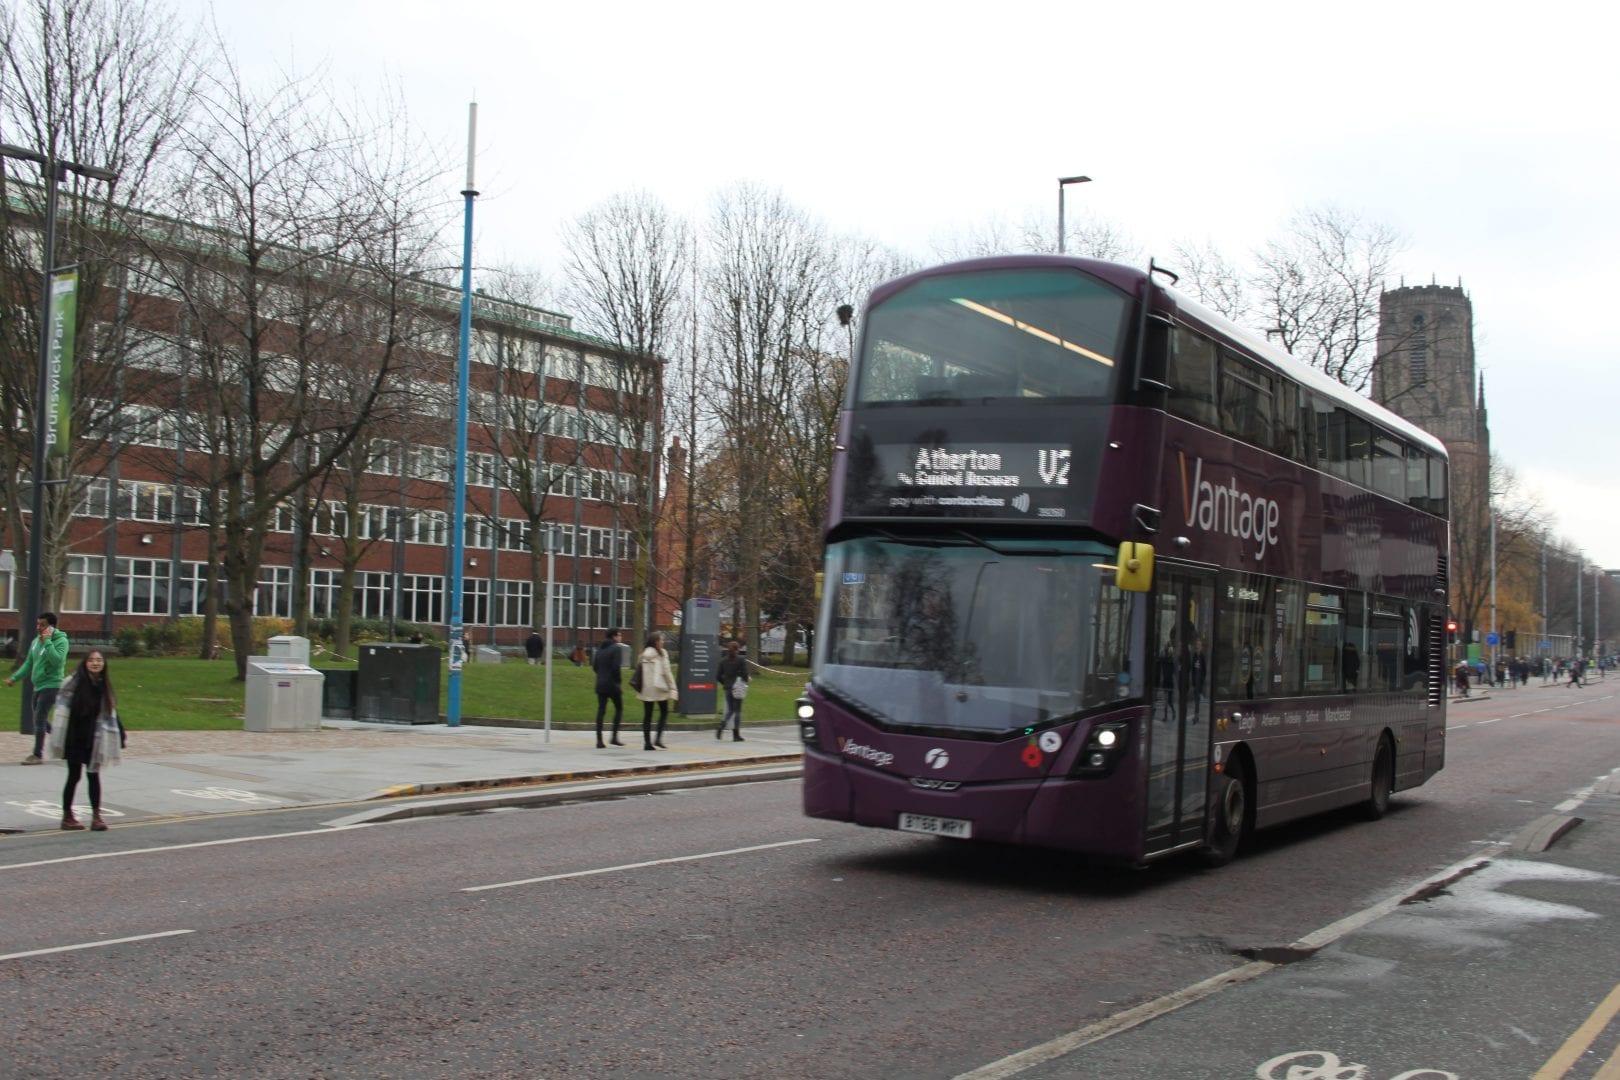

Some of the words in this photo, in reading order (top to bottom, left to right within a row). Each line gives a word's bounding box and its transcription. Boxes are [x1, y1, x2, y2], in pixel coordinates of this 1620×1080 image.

[53, 311, 65, 350] Park
[47, 354, 62, 444] Brunswick
[915, 448, 1001, 470] Atherton
[1038, 449, 1071, 485] V2
[1179, 451, 1279, 560] Vantage
[838, 736, 895, 766] Vantage
